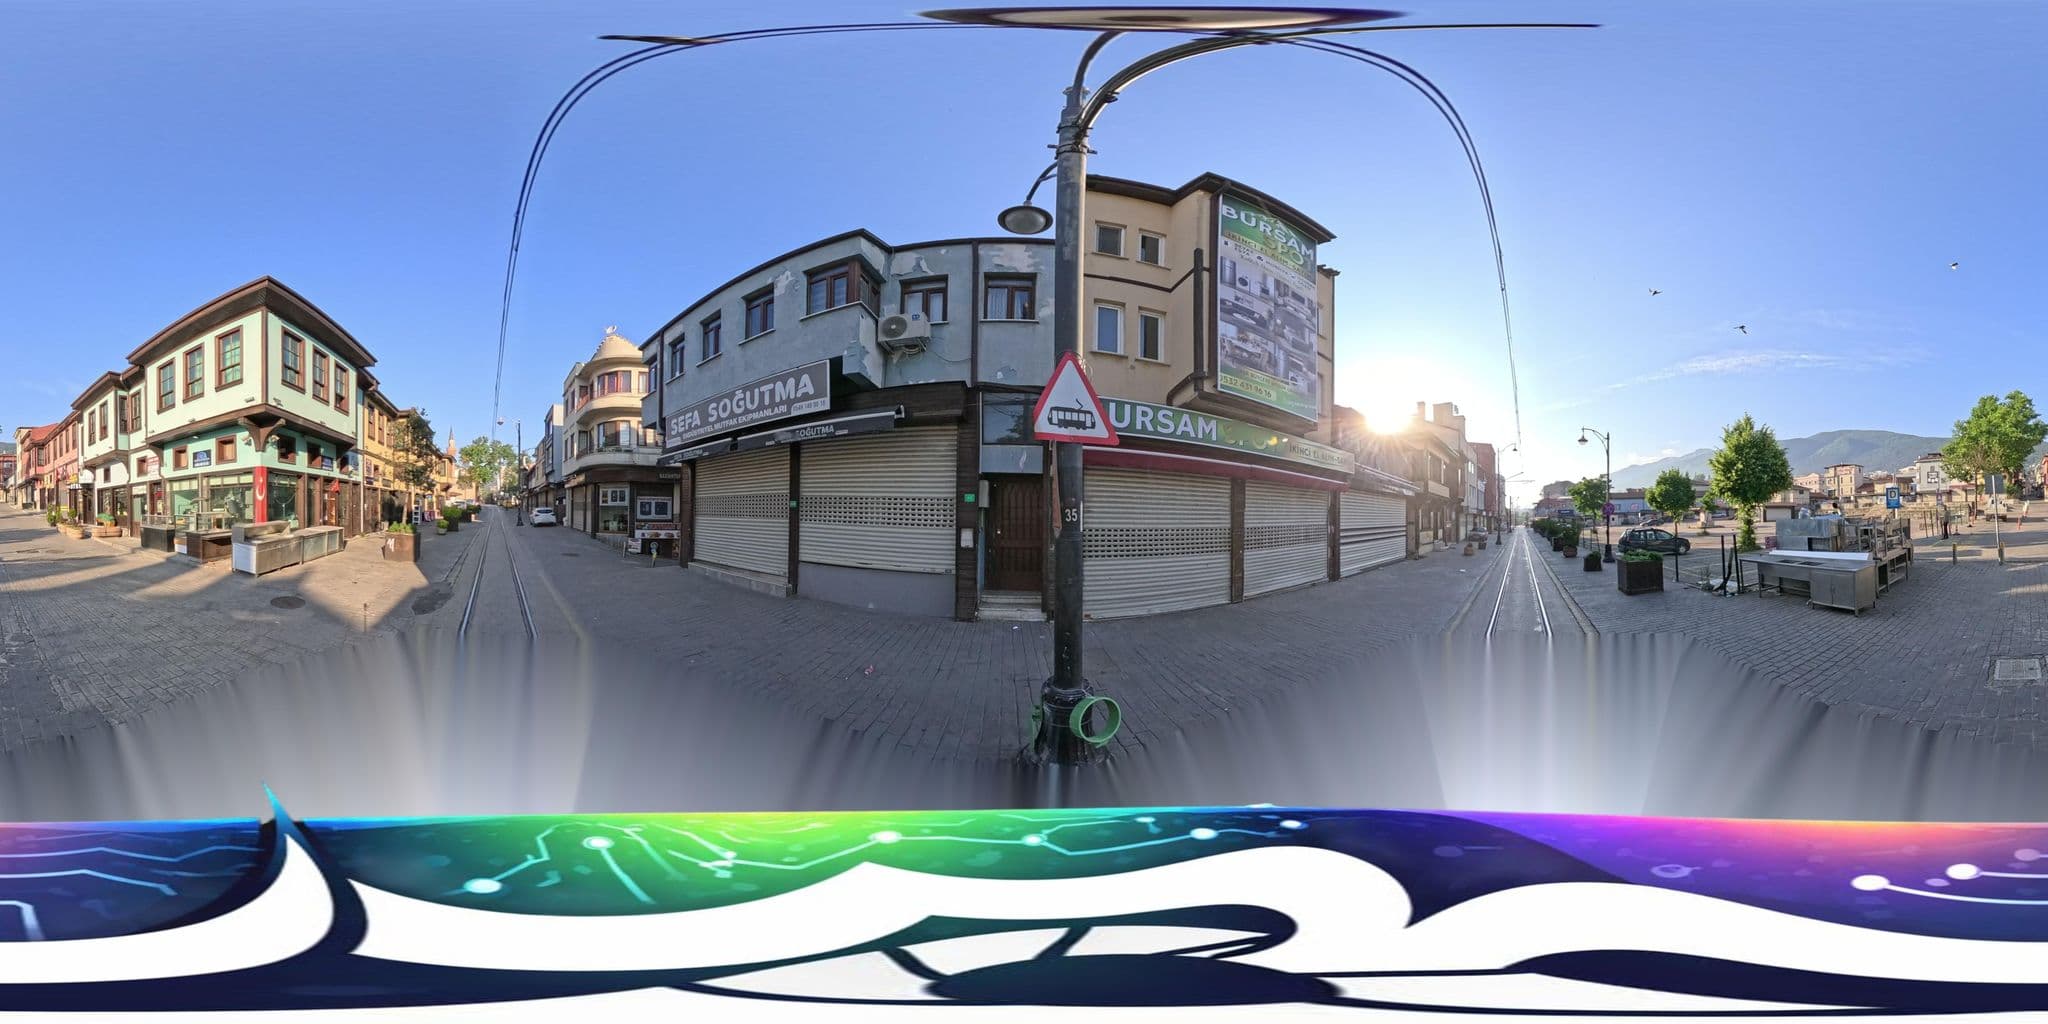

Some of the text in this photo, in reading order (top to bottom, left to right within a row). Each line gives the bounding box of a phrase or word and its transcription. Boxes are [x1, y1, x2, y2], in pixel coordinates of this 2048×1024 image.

[1222, 205, 1314, 260] BURSAM
[670, 373, 815, 435] SEFA SOĞUTMA
[1109, 402, 1217, 441] URSAM
[796, 424, 834, 438] OĞUTMA
[1064, 508, 1078, 522] 35
